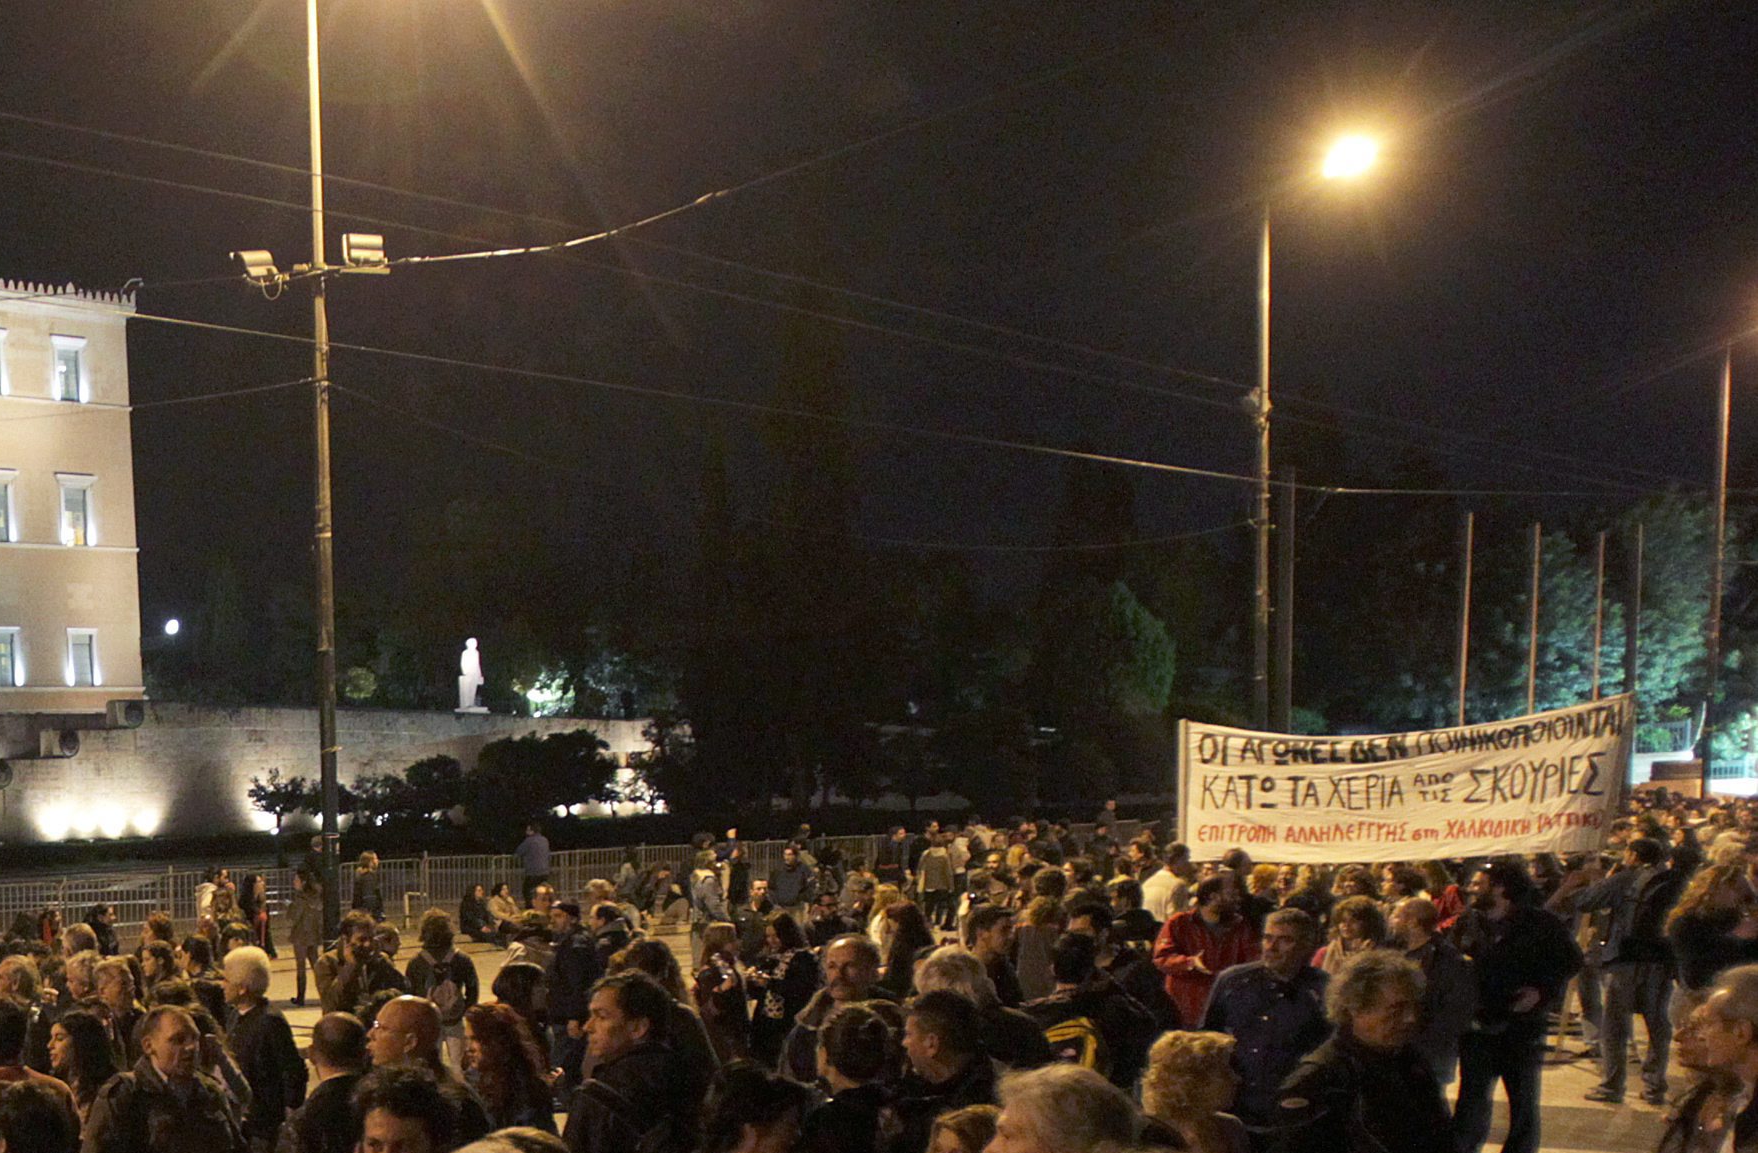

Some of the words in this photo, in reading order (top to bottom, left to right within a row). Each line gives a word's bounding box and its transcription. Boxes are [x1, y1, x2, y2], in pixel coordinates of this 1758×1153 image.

[1199, 734, 1228, 766] ΟΙ
[1350, 733, 1409, 763] ΔΕΝ
[1201, 774, 1277, 810] ΚΑΤΩ
[1286, 775, 1320, 807] ΤΑ
[1326, 773, 1404, 811] ΧΕΡΙΑ
[1413, 771, 1455, 788] ΑΠΟ
[1463, 751, 1607, 806] ΣΚΟΥΡΙΕΣ
[1419, 788, 1453, 804] ΤΙΣ
[1197, 823, 1277, 843] ΕΠΙΤΡΟΠΗ
[1284, 821, 1410, 844] ΑΛΛΗΛΕΓΓΥΗΣ
[1443, 817, 1532, 841] ΧΑΛΚΙΔΙΚΗ
